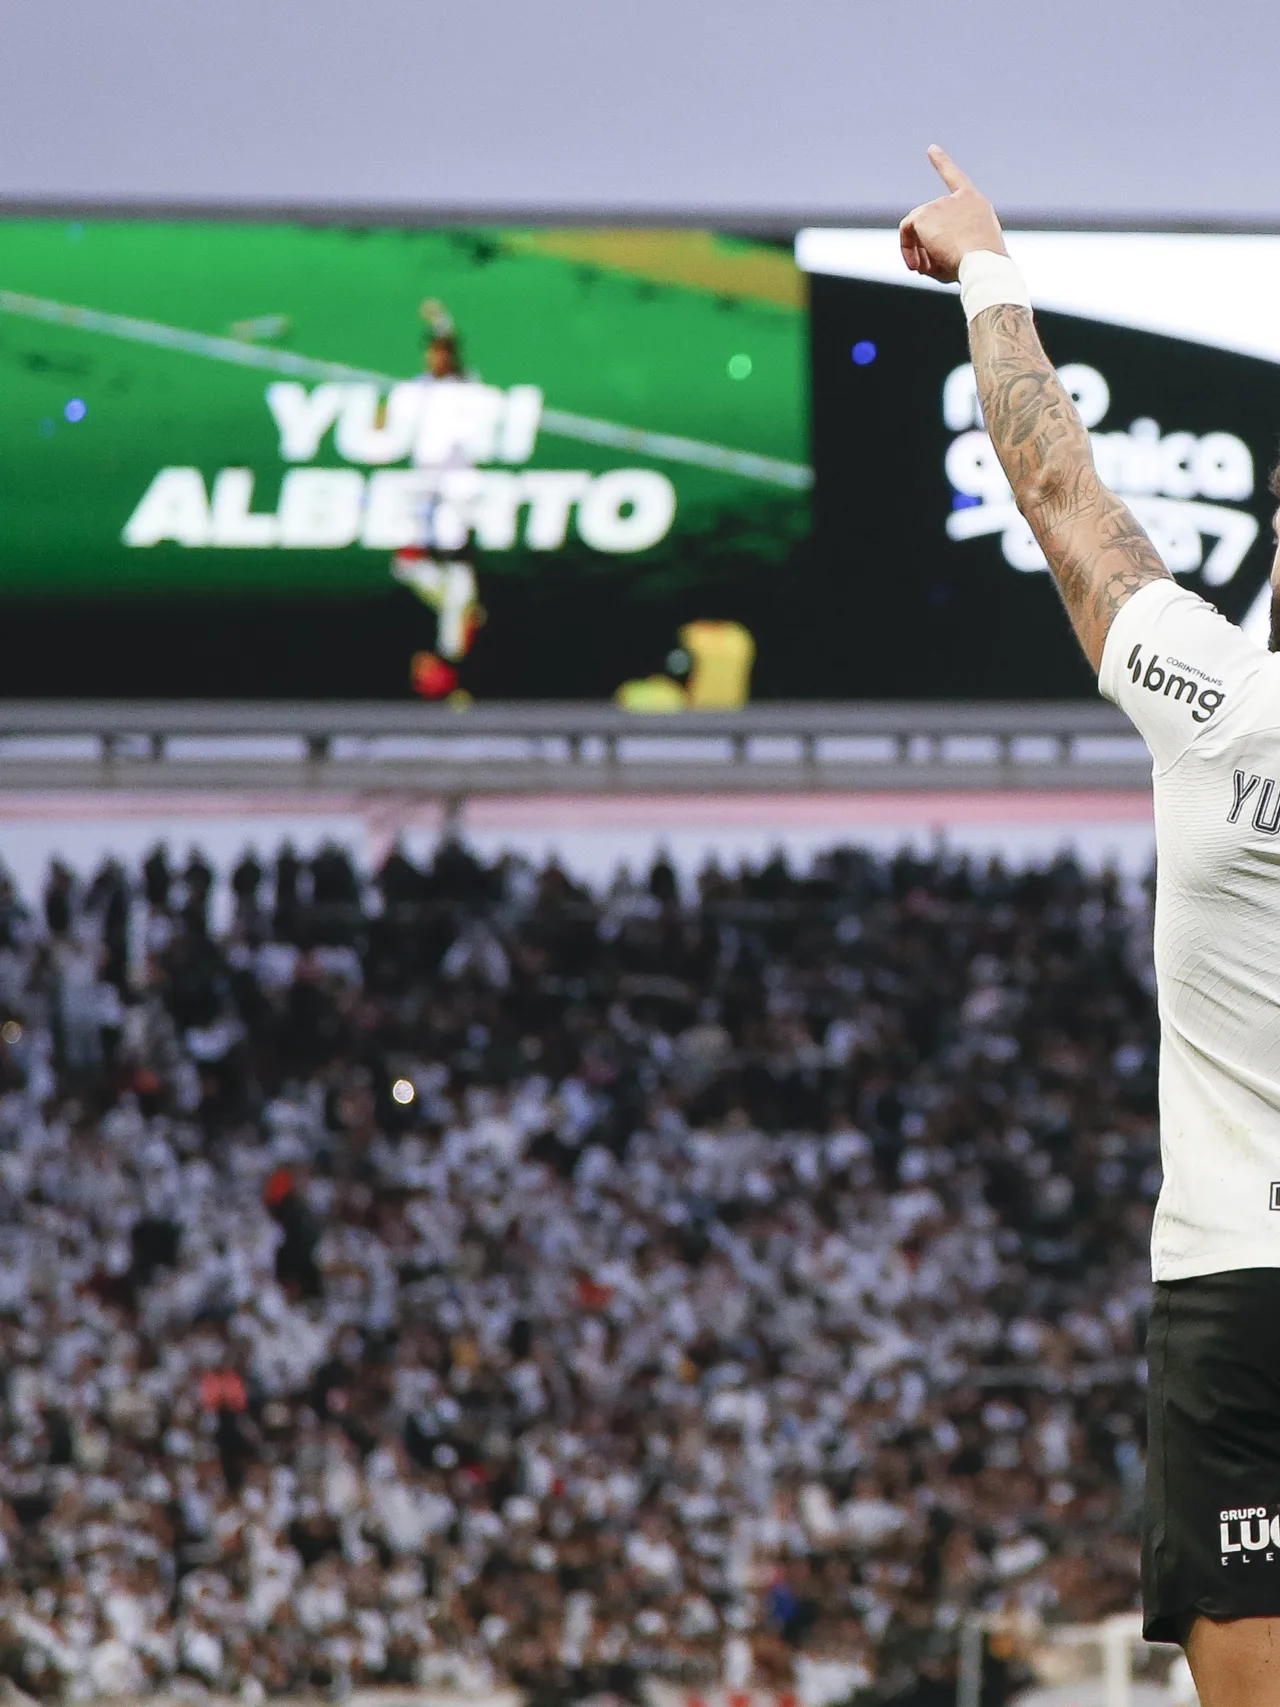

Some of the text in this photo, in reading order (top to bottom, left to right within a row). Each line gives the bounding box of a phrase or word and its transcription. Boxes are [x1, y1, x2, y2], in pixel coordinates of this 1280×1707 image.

[267, 380, 544, 464] YURI
[943, 362, 1111, 432] no
[122, 466, 677, 553] ALBERTO
[1142, 654, 1227, 723] bmg
[1165, 656, 1224, 687] CORINTHIANS
[1220, 1507, 1267, 1521] GRUPO
